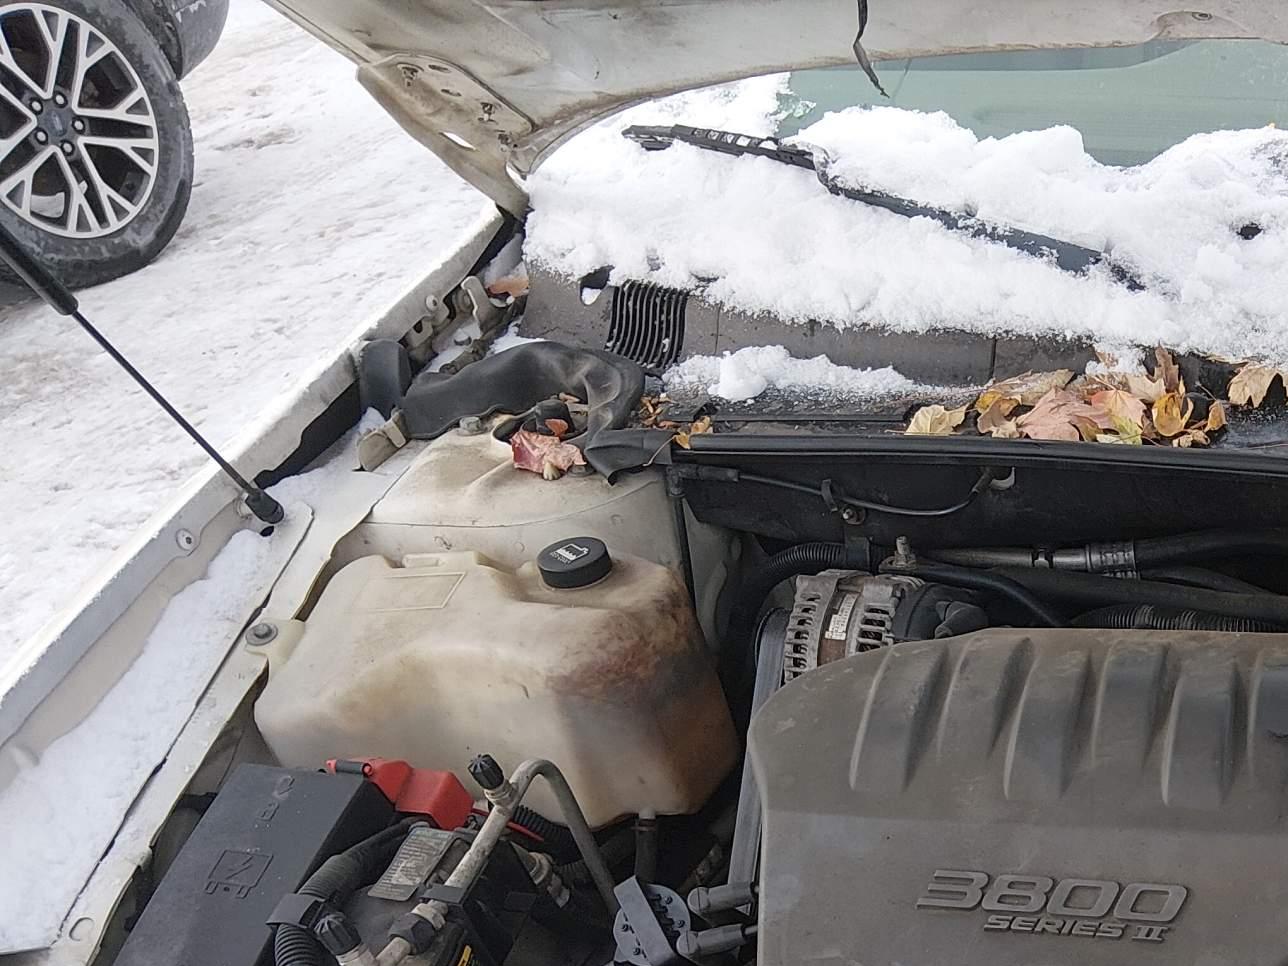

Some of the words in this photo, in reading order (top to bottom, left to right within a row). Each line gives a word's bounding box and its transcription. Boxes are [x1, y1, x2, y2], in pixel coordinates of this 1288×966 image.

[916, 869, 1188, 922] 3800
[984, 914, 1128, 938] SERIES
[1130, 925, 1169, 942] II
